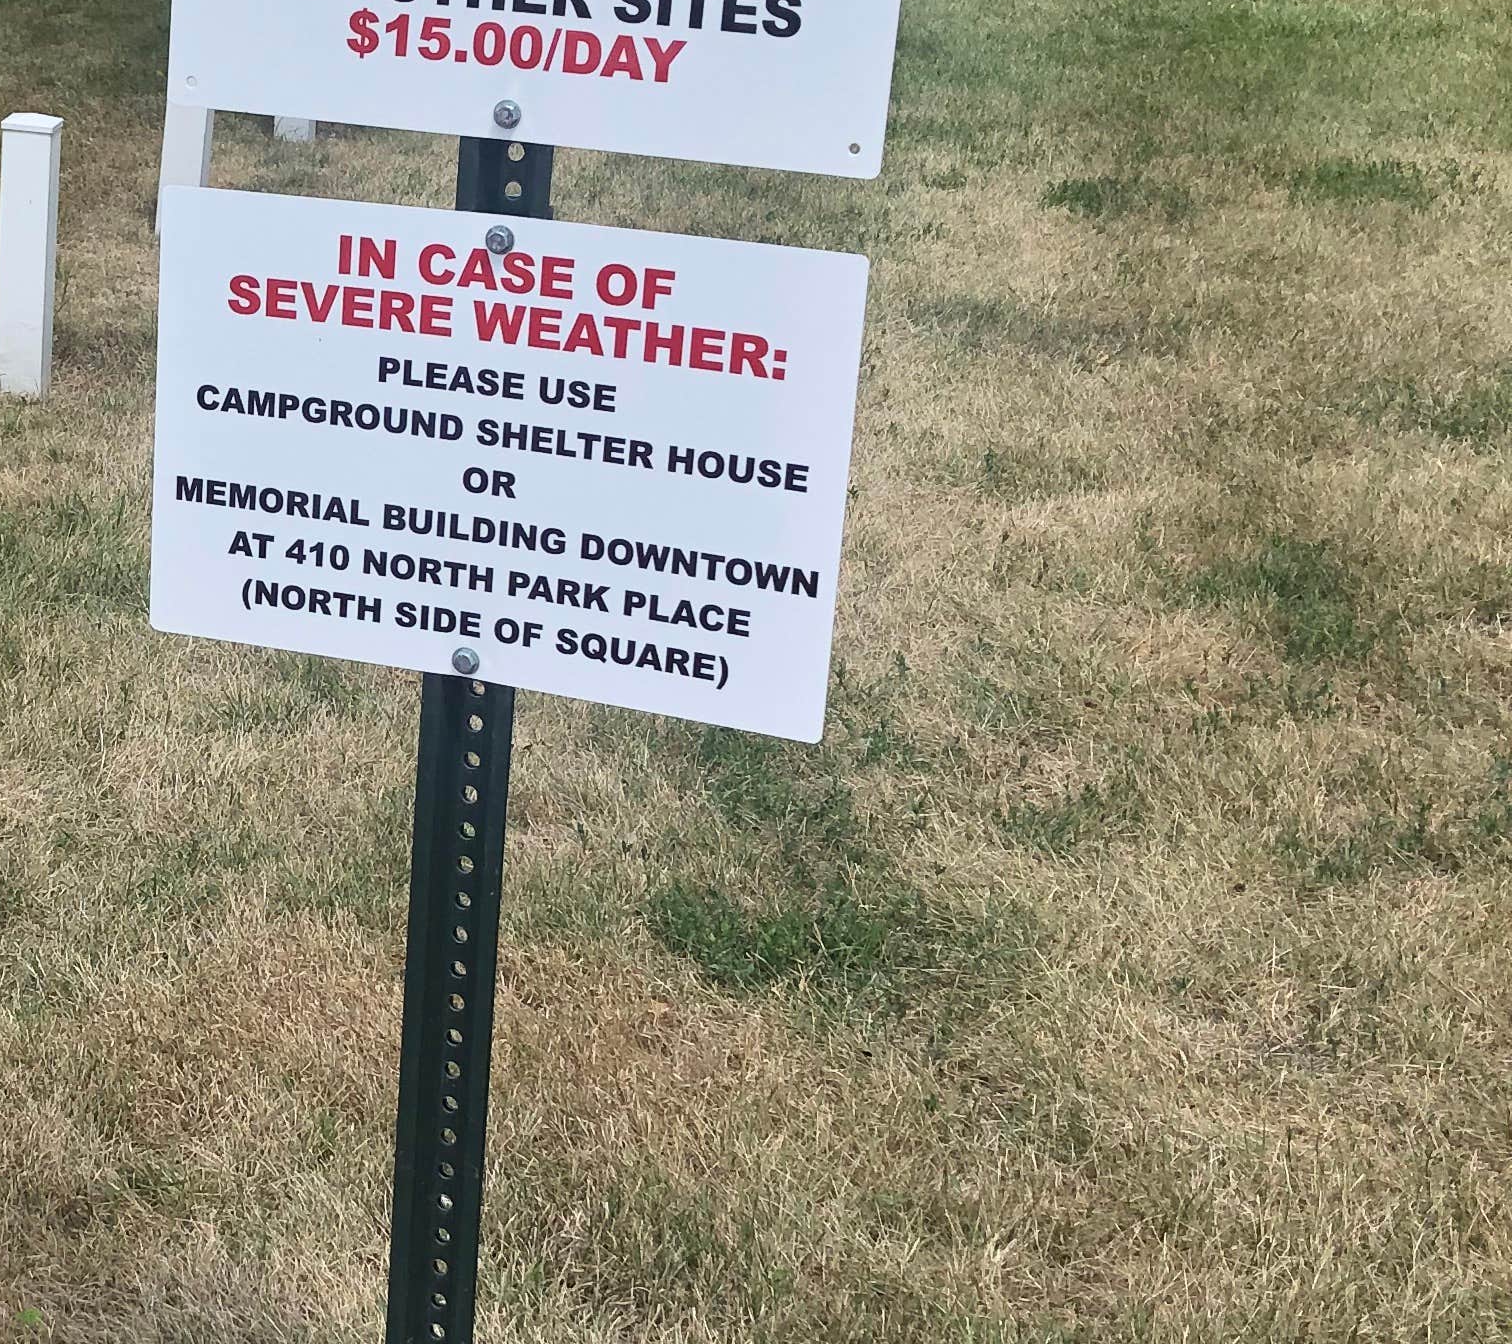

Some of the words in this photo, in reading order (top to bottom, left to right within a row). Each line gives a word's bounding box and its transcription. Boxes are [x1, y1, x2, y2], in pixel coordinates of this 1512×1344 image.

[347, 8, 686, 82] $15.00/DAY
[339, 235, 396, 279] IN
[419, 244, 575, 299] CASE
[596, 264, 675, 309] OF
[228, 275, 453, 337] SEVERE
[474, 301, 787, 380] WEATHER:
[379, 357, 524, 400] PLEASE
[540, 377, 616, 412] USE
[197, 385, 463, 440] CAMPGROUND
[477, 419, 653, 469] SHELTER
[668, 446, 809, 492] HOUSE
[463, 467, 515, 498] OR
[176, 476, 369, 526] MEMORIAL
[383, 504, 565, 554] BUILDING
[581, 533, 818, 598] DOWNTOWN
[229, 531, 274, 558] AT
[286, 539, 349, 570] 410
[363, 549, 493, 592] NORTH
[508, 571, 610, 612] PARK
[624, 590, 750, 637] PLACE
[242, 579, 381, 623] (NORTH
[395, 602, 481, 638] SIDE
[494, 618, 543, 647] OF
[556, 629, 728, 689] SQUARE)
